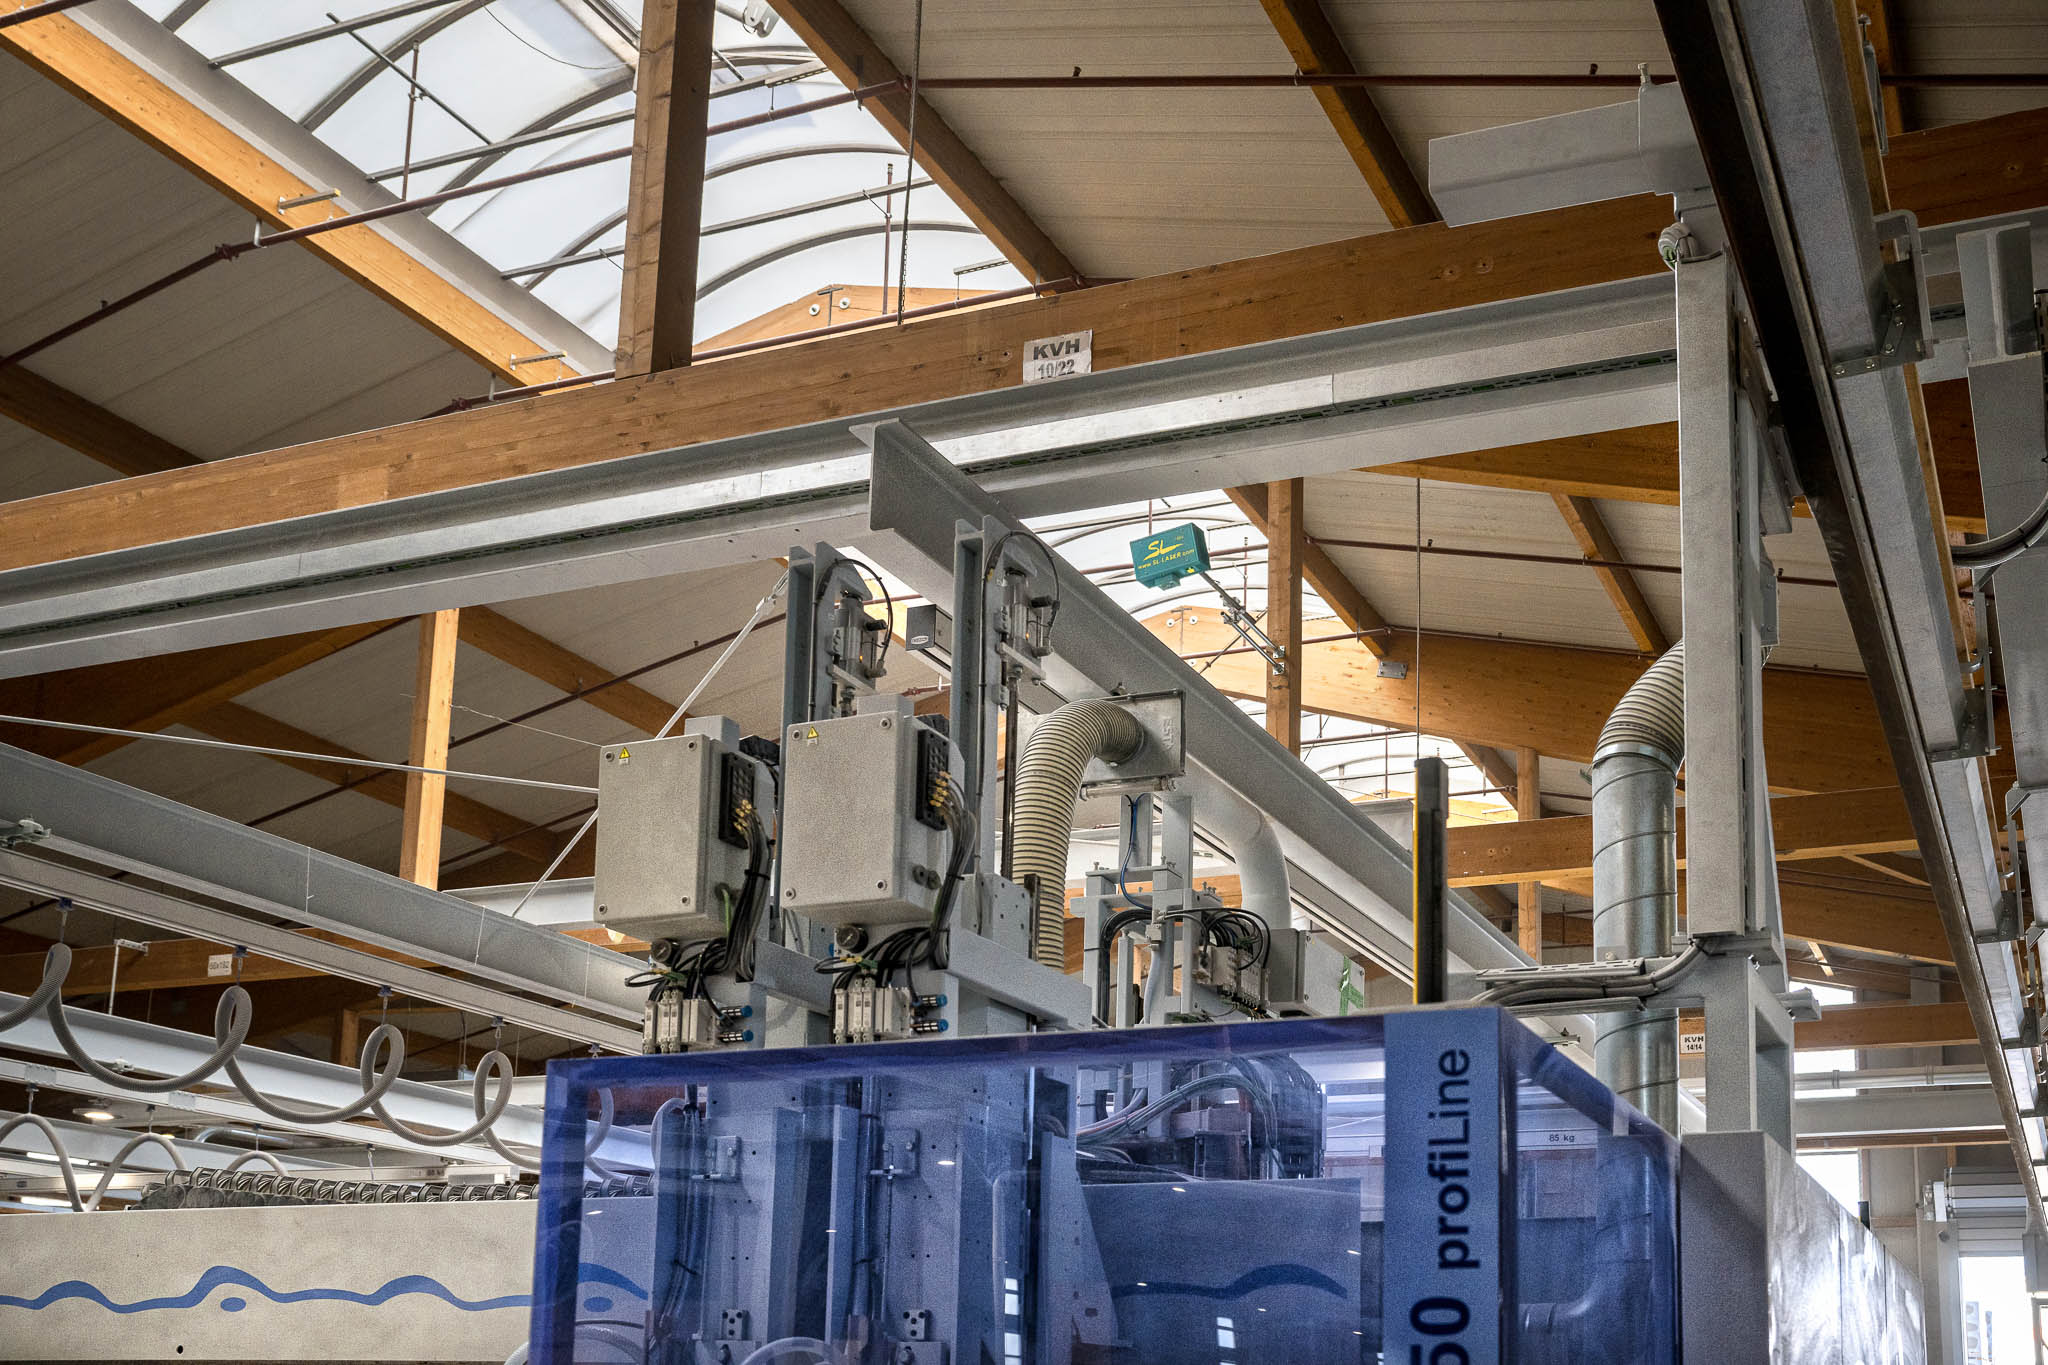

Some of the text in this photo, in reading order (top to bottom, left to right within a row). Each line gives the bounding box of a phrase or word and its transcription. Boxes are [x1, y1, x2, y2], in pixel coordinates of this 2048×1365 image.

[1033, 339, 1080, 360] KVH
[1038, 359, 1075, 379] 10/22
[1563, 1134, 1575, 1143] kg
[1427, 1049, 1481, 1270] profiLine
